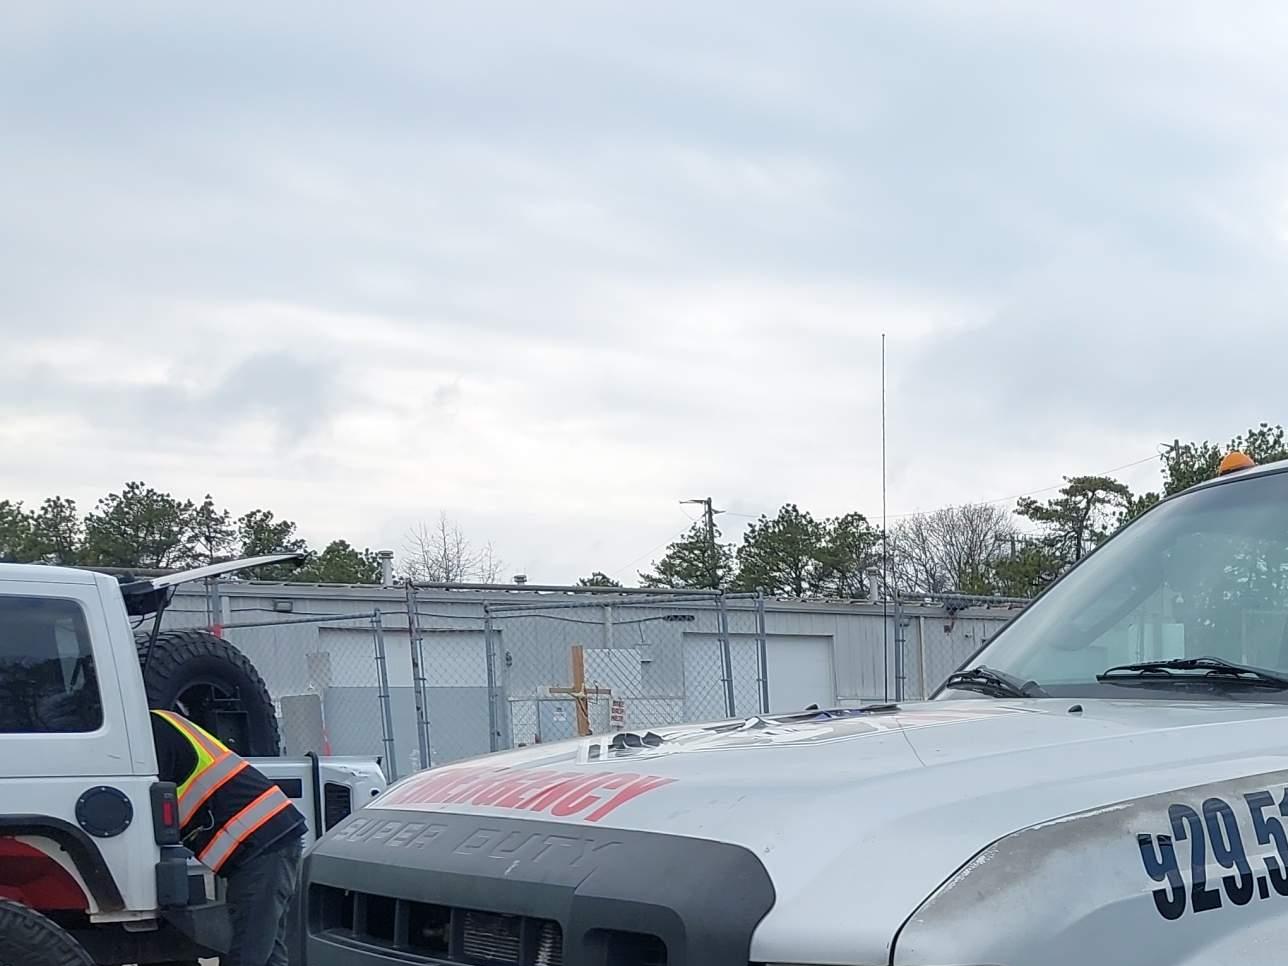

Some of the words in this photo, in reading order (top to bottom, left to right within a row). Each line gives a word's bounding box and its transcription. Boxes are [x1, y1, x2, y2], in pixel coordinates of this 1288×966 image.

[388, 767, 680, 822] EMERGENCY
[332, 816, 449, 850] SUPER
[451, 827, 624, 866] DUTY
